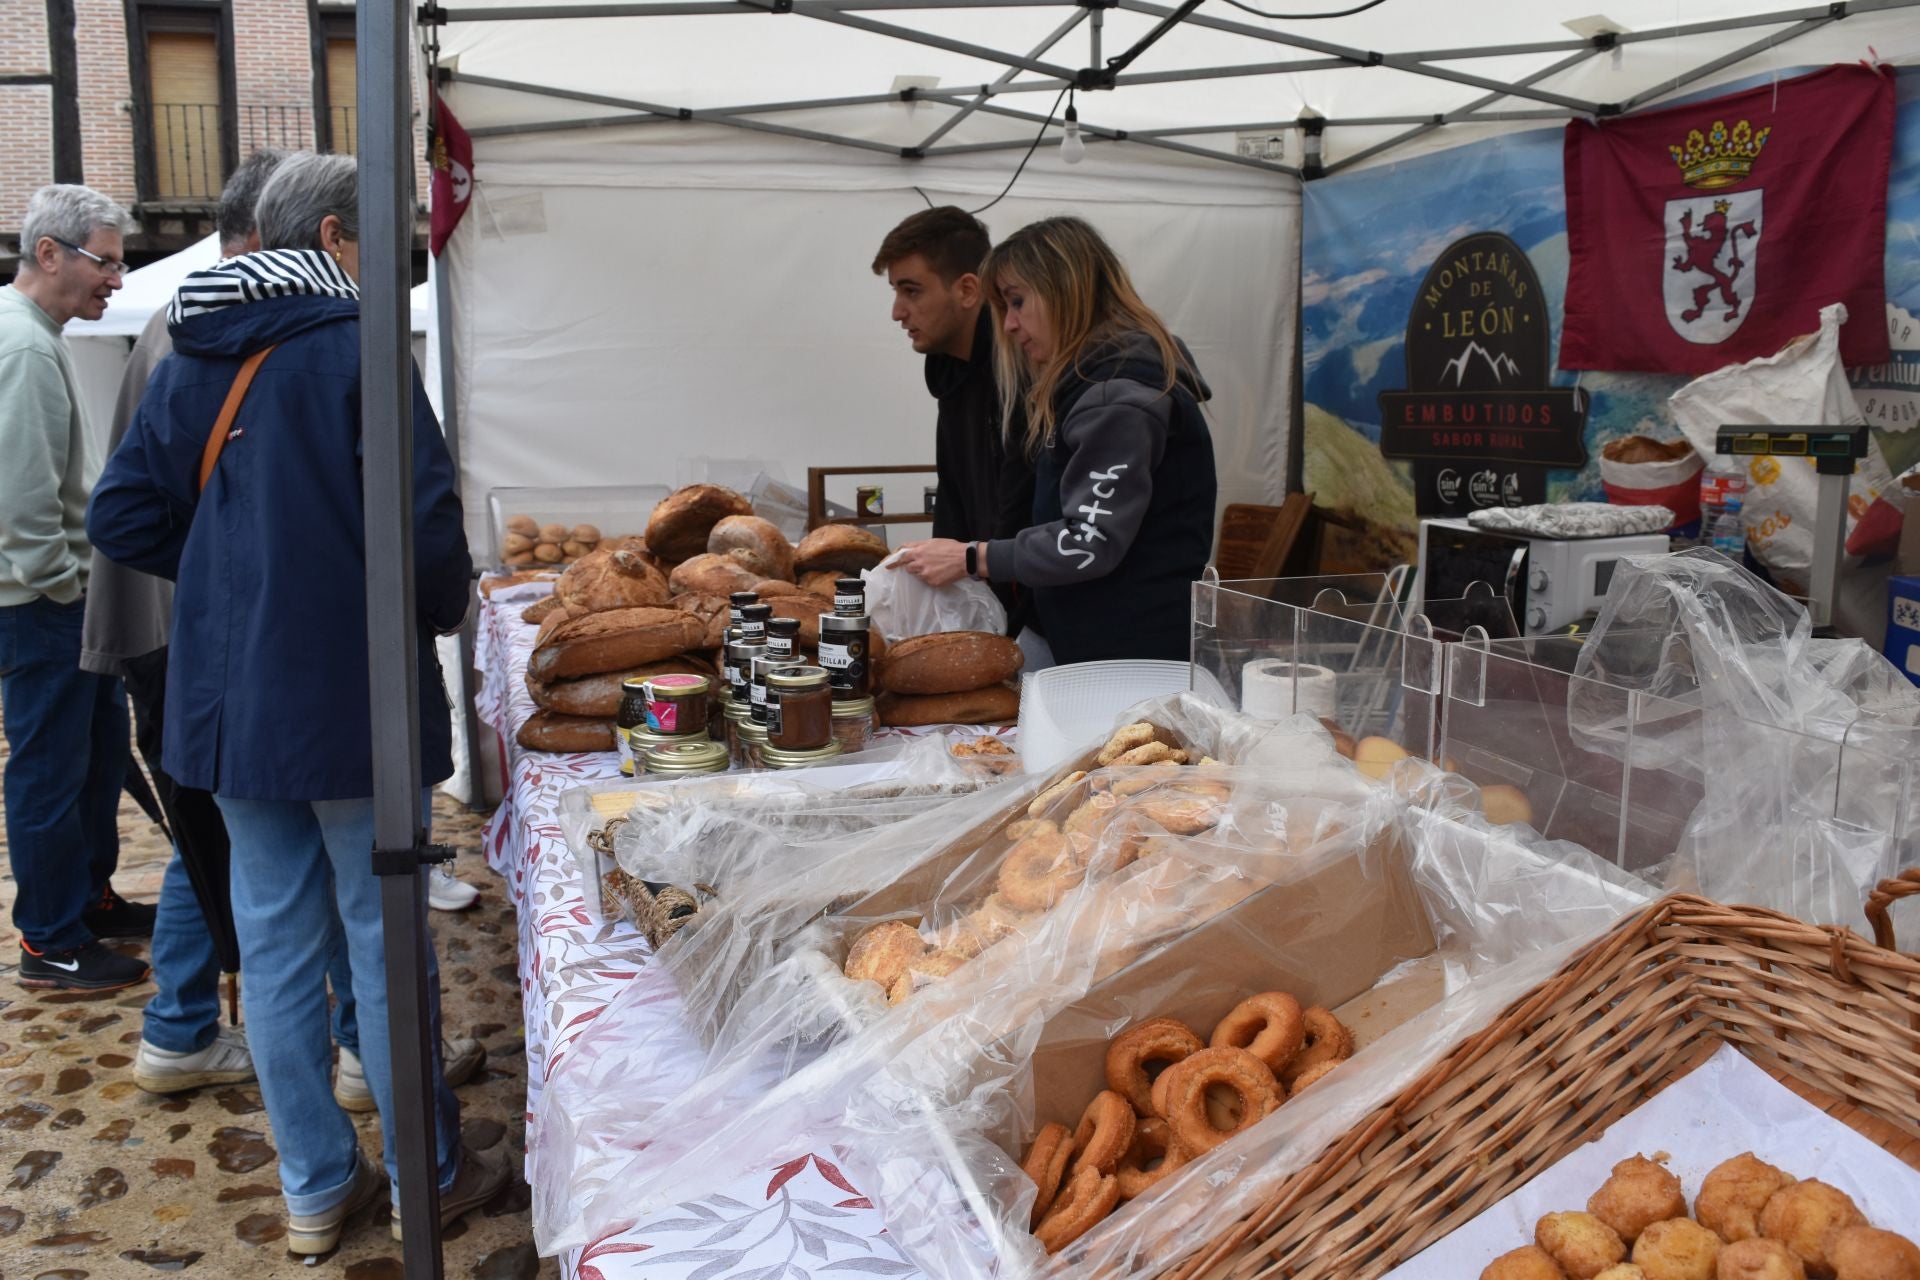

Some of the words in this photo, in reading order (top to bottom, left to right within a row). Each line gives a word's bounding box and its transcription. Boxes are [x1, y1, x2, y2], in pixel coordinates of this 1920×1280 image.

[1425, 252, 1527, 308] MONTAÑAS
[1470, 281, 1492, 297] DE
[1442, 302, 1514, 337] LEÓN
[1405, 404, 1551, 424] EMBUTIDOS
[1432, 432, 1483, 446] SABOR
[1441, 477, 1455, 490] sin
[1472, 480, 1487, 493] sin
